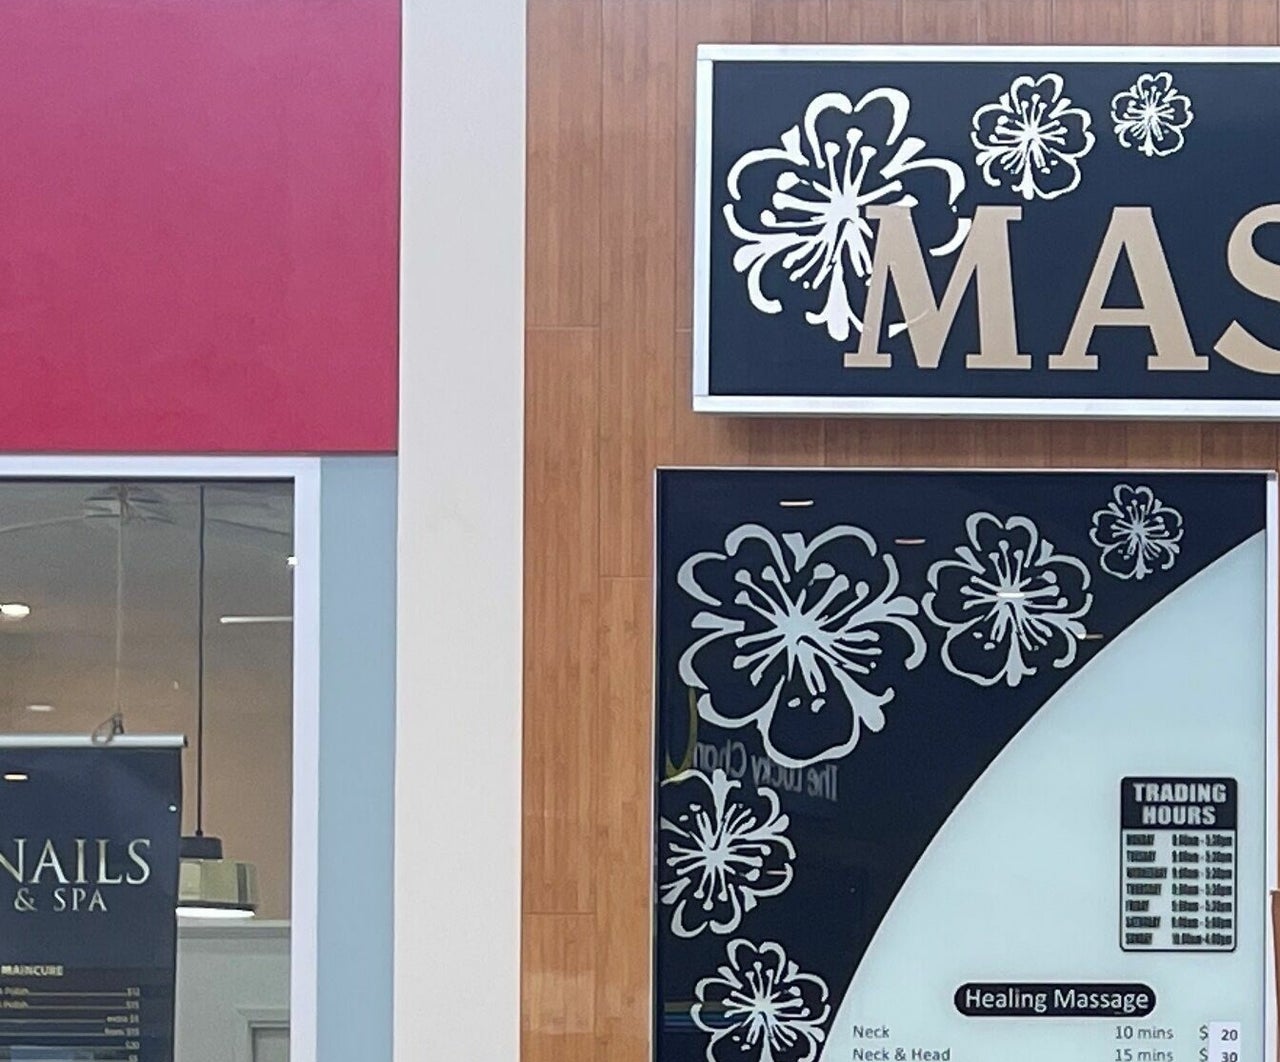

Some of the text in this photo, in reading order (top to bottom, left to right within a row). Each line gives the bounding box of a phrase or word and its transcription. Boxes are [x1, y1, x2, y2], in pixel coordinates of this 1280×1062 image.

[1133, 783, 1227, 803] TRADING
[1142, 805, 1216, 825] HOURS
[0, 838, 150, 885] NAILS
[14, 887, 107, 912] & SPA
[965, 988, 1149, 1013] Healing Massage
[853, 1025, 889, 1039] Neck
[853, 1048, 950, 1061] Neck & Head
